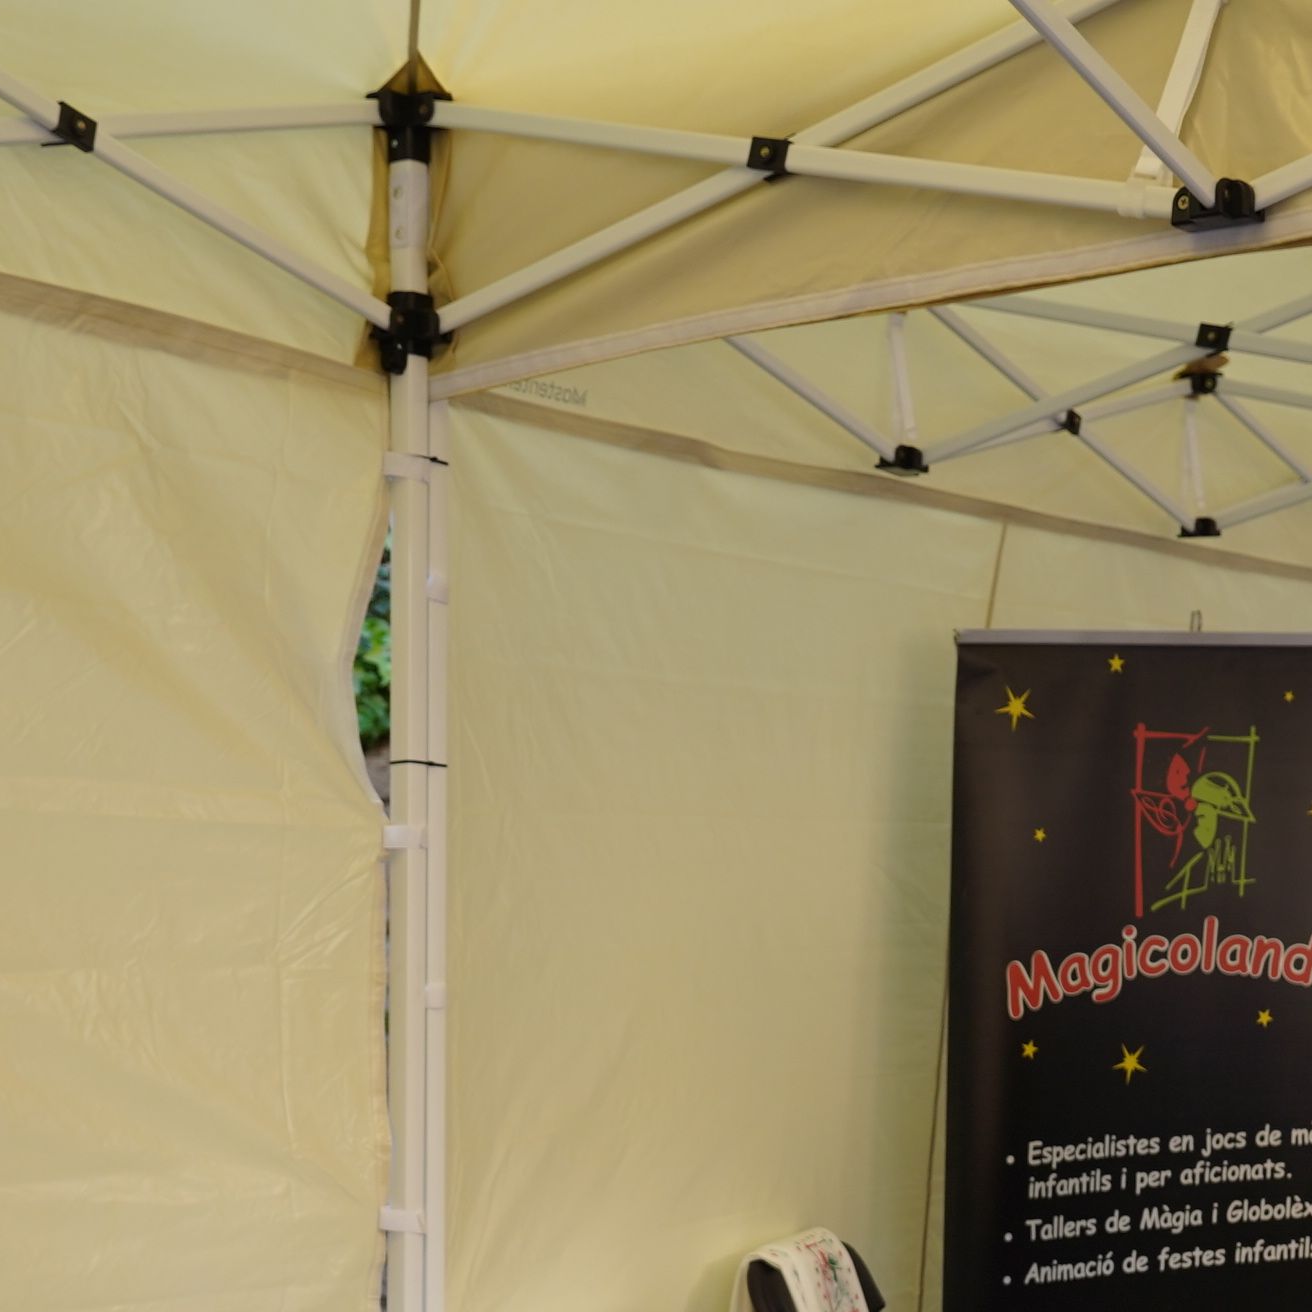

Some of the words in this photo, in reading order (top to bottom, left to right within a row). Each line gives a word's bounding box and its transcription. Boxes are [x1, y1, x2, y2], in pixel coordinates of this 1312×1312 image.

[1027, 1134, 1160, 1168] Especialistes
[1169, 1132, 1194, 1152] en
[1201, 1128, 1246, 1157] jocs
[1255, 1123, 1282, 1148] de
[1028, 1168, 1112, 1199] infantils
[1120, 1167, 1127, 1190] i
[1135, 1165, 1172, 1195] per
[1180, 1158, 1292, 1186] aficionats.
[1025, 1214, 1097, 1241] Tallers
[1105, 1209, 1131, 1234] de
[1140, 1205, 1203, 1234] Màgia
[1212, 1202, 1219, 1224] i
[1024, 1251, 1114, 1286] Animació
[1122, 1249, 1148, 1274] de
[1158, 1245, 1225, 1271] festes
